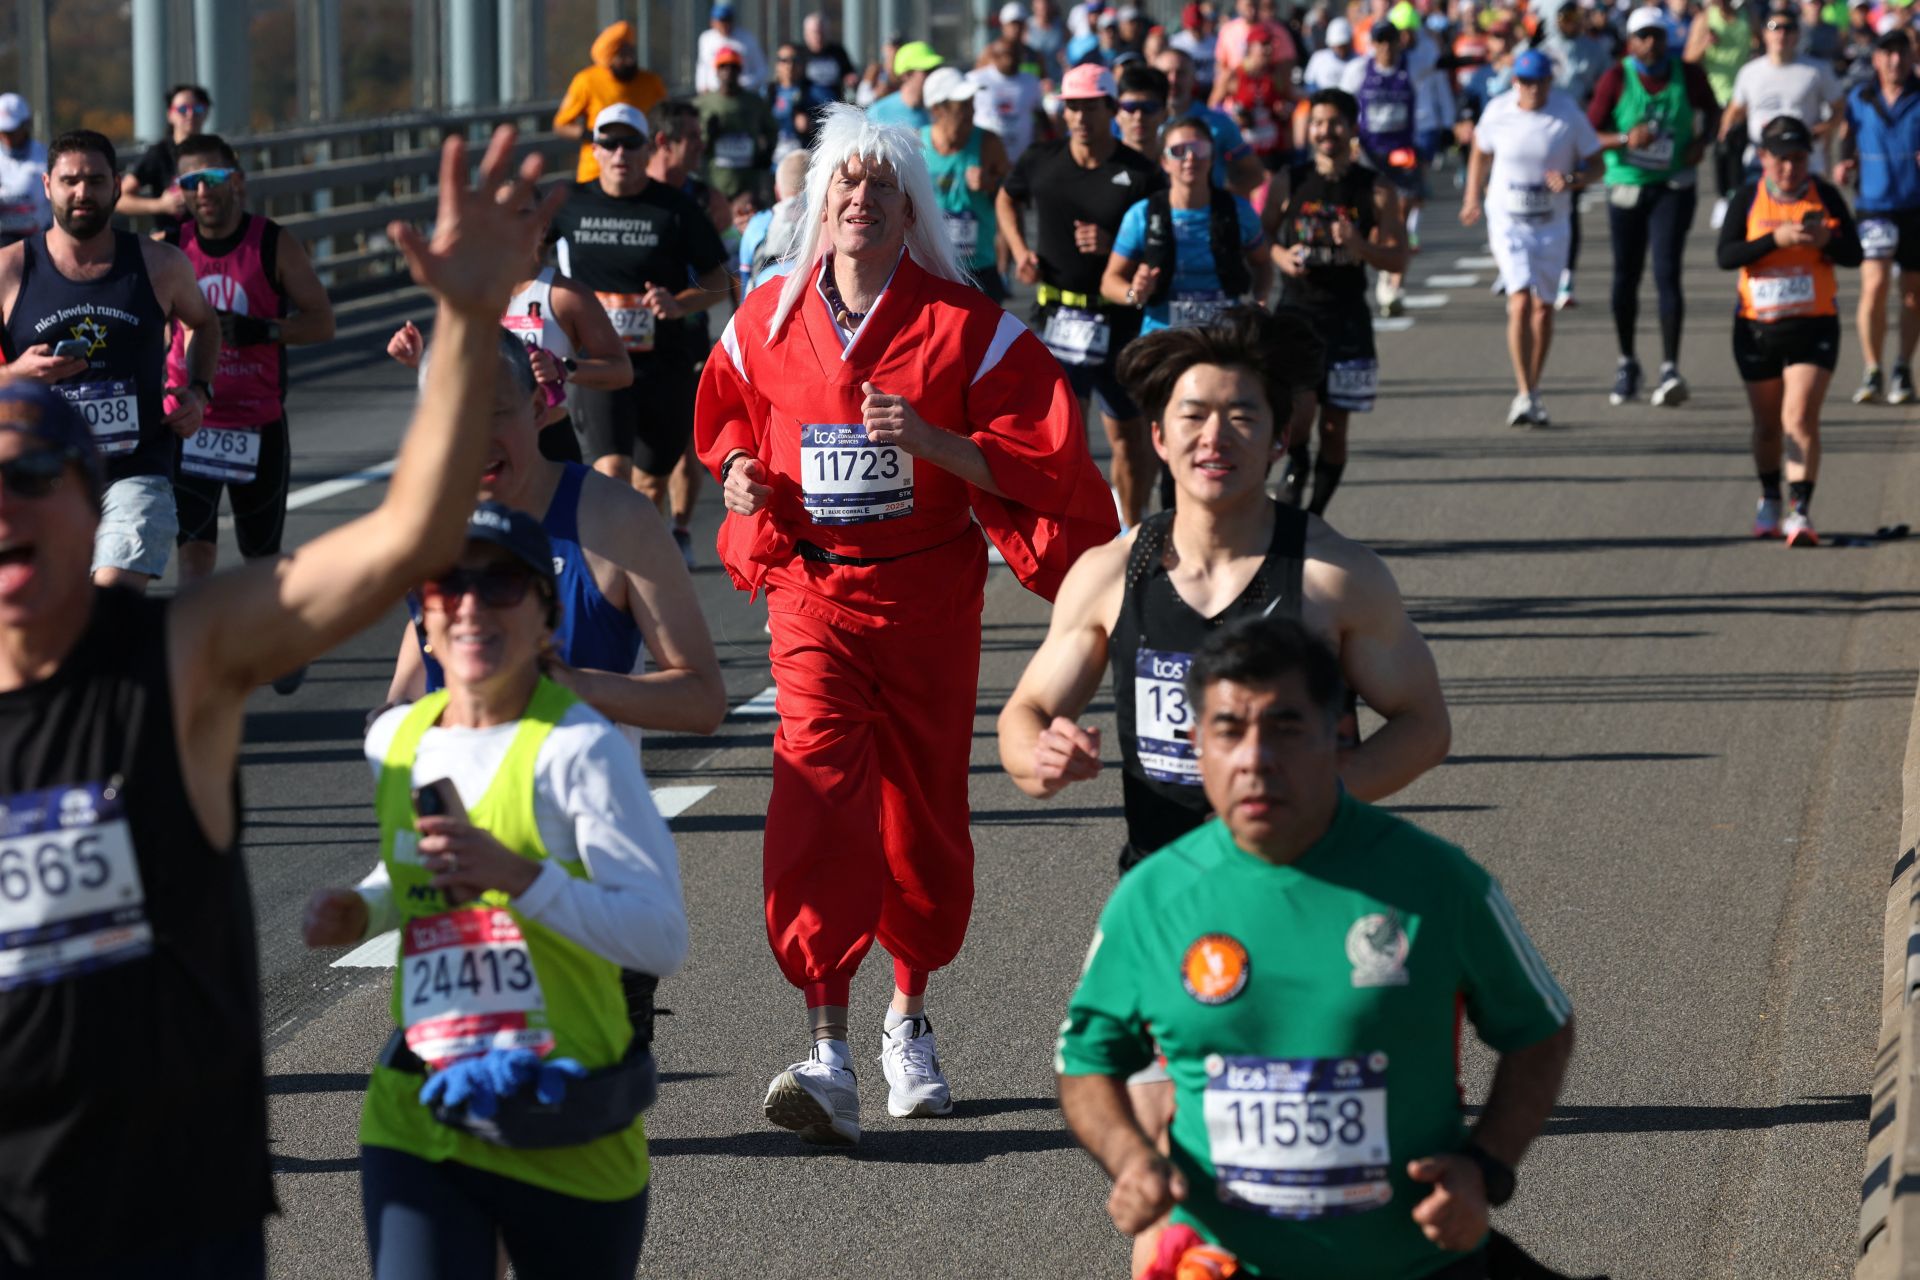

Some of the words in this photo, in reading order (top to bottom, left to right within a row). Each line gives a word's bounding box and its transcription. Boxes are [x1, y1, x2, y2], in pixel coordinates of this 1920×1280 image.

[580, 217, 652, 232] MAMMOTH
[573, 230, 619, 244] TRACK
[621, 232, 659, 246] CLUB
[34, 312, 59, 333] nice
[57, 303, 95, 321] Jewish
[96, 306, 139, 326] runners
[613, 310, 649, 328] 972
[84, 399, 129, 426] 038
[195, 429, 248, 455] 8763
[814, 428, 836, 444] tcs
[814, 449, 900, 481] 11723
[864, 506, 870, 514] E
[884, 501, 906, 511] 2025
[1153, 656, 1184, 679] tcs
[1148, 685, 1188, 724] 13
[0, 834, 110, 902] 665
[412, 948, 533, 1006] 24413
[1227, 1064, 1267, 1090] tcs
[1227, 1097, 1365, 1146] 11558
